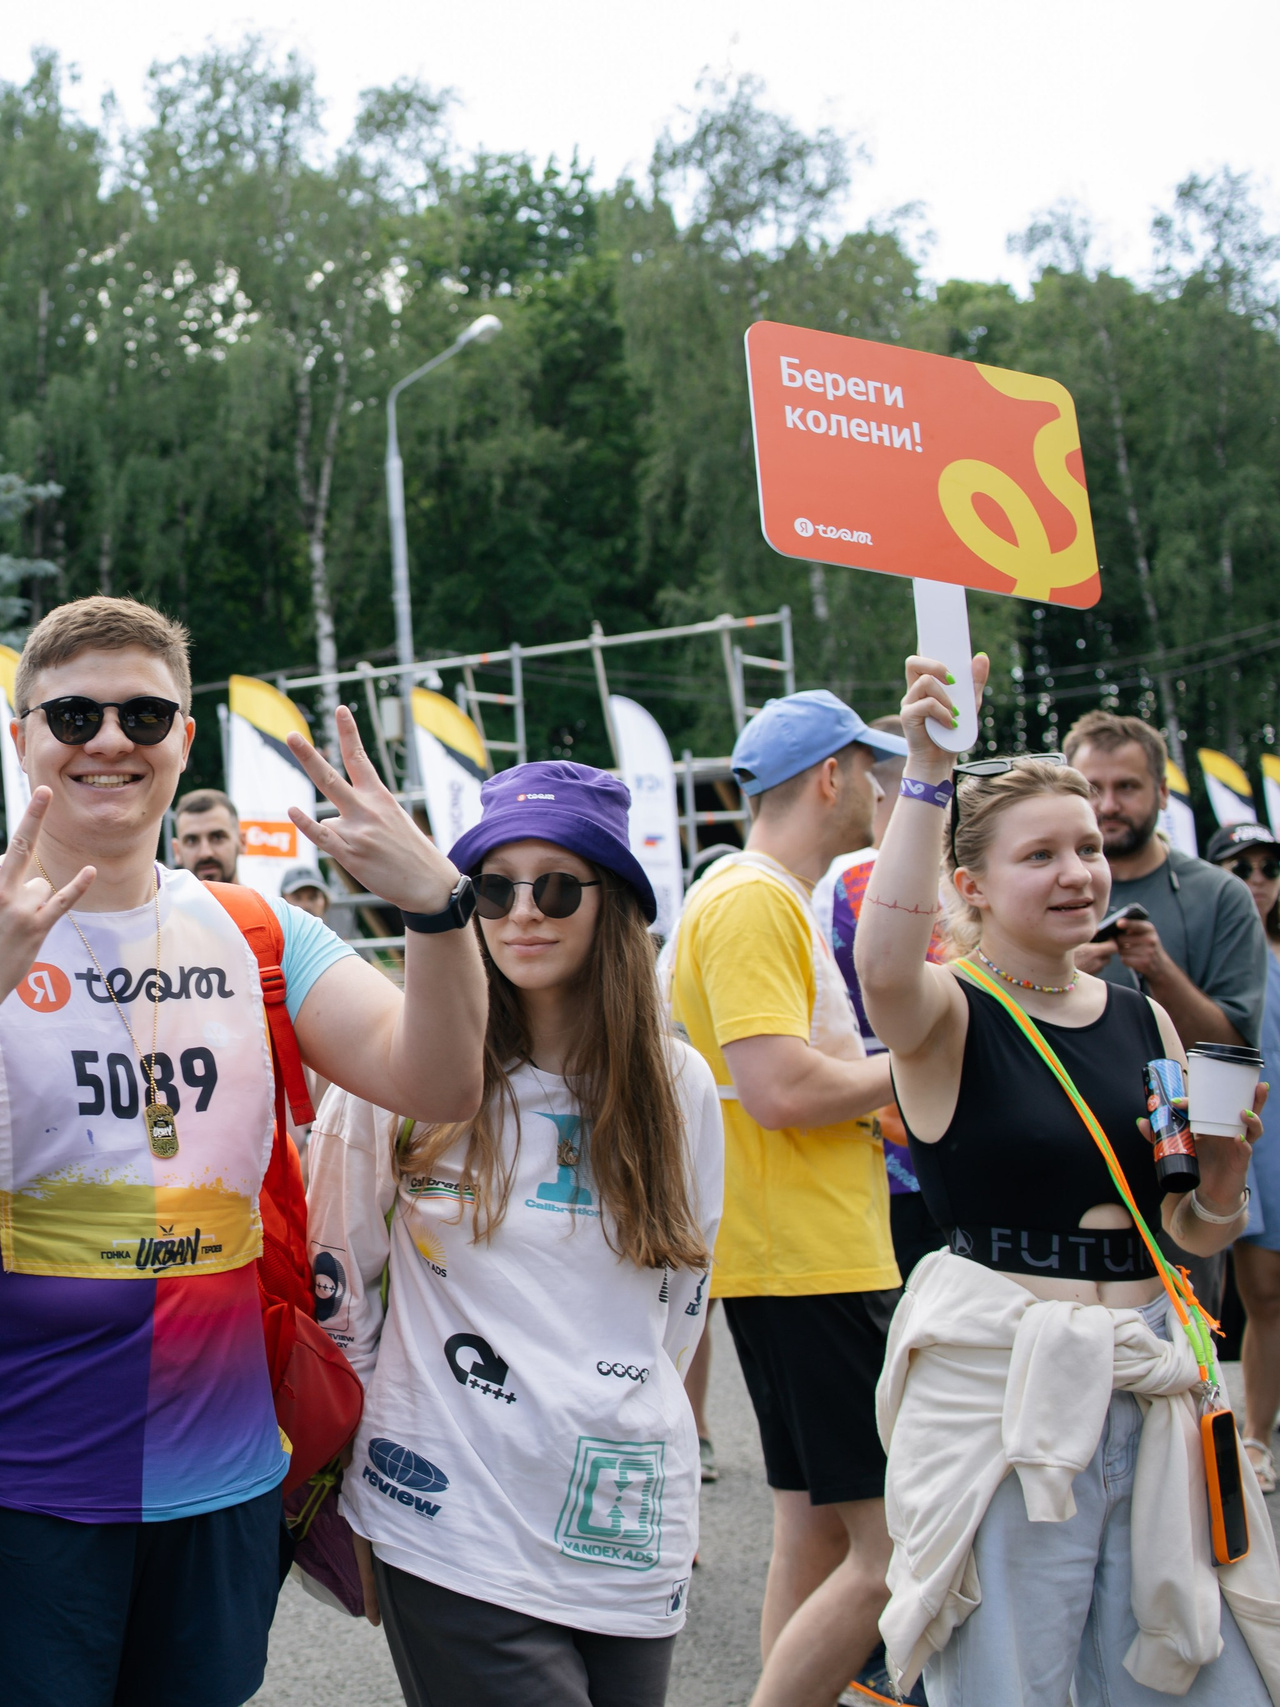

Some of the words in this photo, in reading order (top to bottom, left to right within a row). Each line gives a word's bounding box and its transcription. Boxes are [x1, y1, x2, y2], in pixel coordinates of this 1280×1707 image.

[779, 355, 905, 409] Береги
[784, 405, 924, 453] колени!
[815, 524, 874, 546] team
[74, 966, 235, 1004] team
[71, 1046, 218, 1120] 5089
[101, 1250, 132, 1260] ГОНКА
[135, 1227, 201, 1272] URBAN
[362, 1465, 443, 1518] review
[563, 1540, 622, 1560] YANDEX
[622, 1549, 654, 1563] ADS
